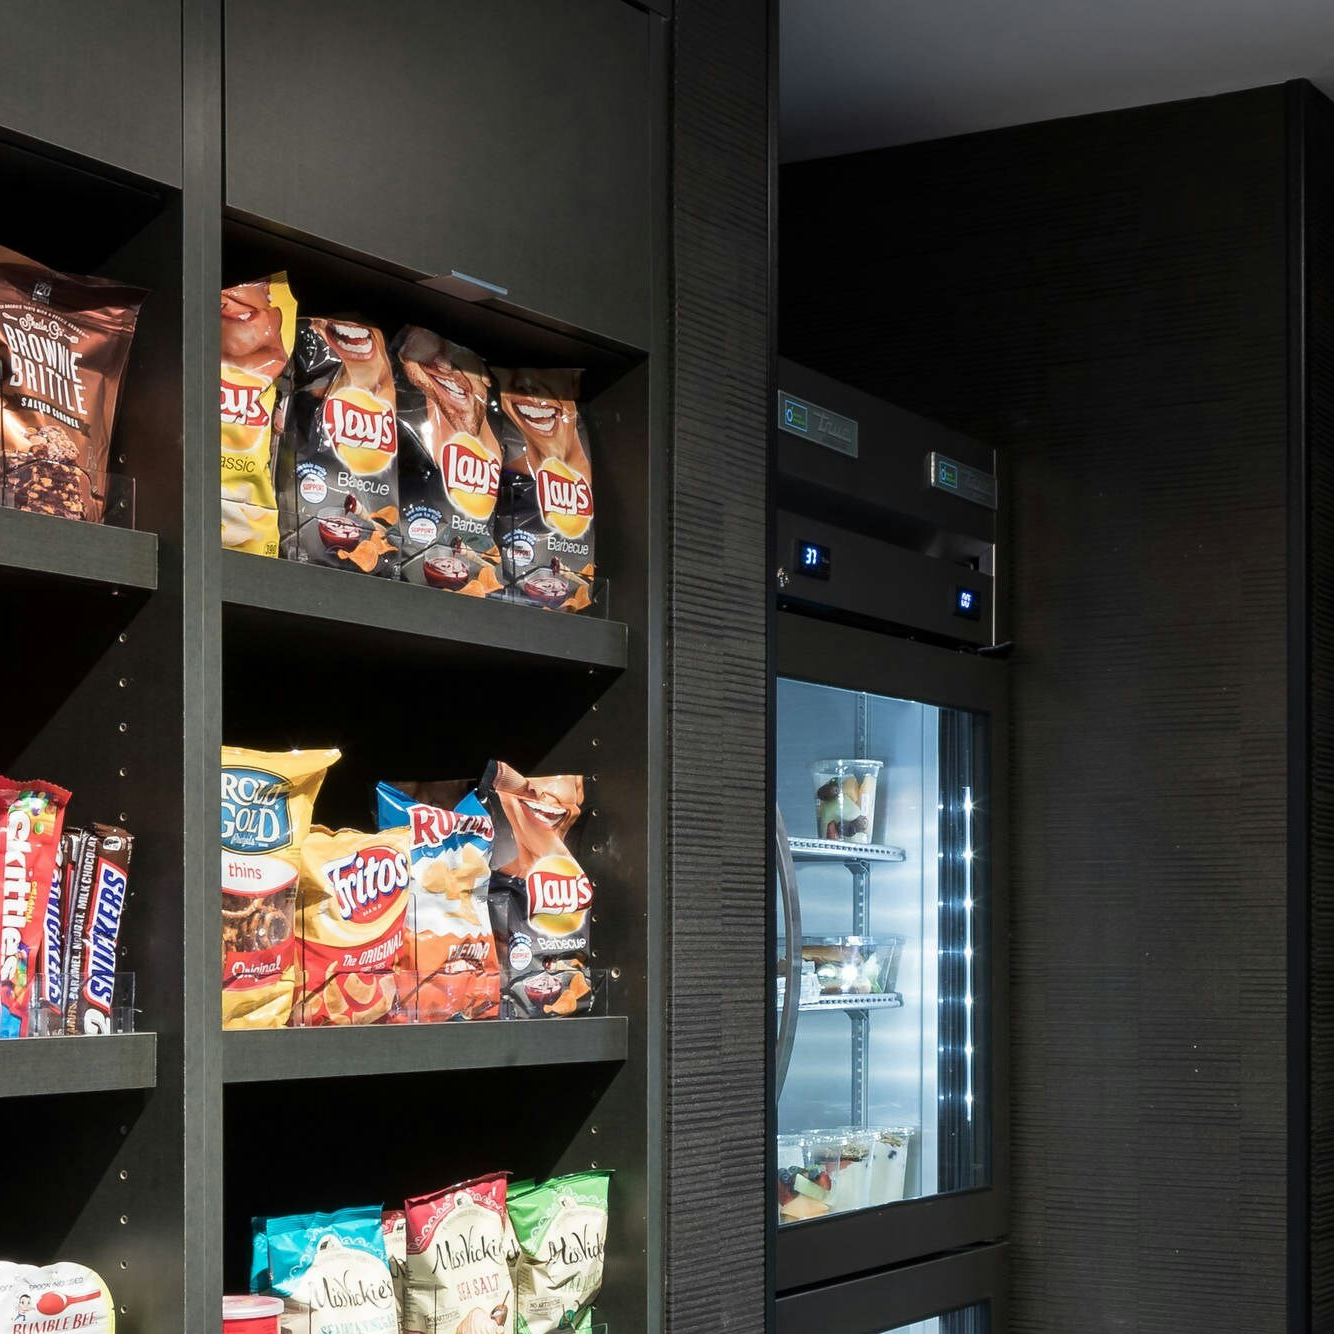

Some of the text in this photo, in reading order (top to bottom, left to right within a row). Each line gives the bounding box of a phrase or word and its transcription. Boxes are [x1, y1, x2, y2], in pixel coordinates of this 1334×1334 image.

[2, 323, 84, 384] BROWNIE
[10, 354, 88, 415] BRITTLE
[331, 398, 395, 449] Lay's
[448, 445, 500, 493] Lay's
[543, 470, 591, 516] Lay's
[547, 537, 589, 555] Barbecue
[805, 548, 817, 565] 37
[228, 862, 262, 880] thins
[327, 853, 409, 920] Fritos
[1, 811, 32, 981] Skittles
[79, 881, 89, 911] MILK
[535, 873, 593, 914] Lay's
[90, 868, 127, 1007] SNICKERS
[343, 952, 357, 967] The
[358, 935, 404, 966] ORIGINAL
[537, 936, 587, 951] Barbecue
[231, 957, 281, 983] Original
[472, 1273, 500, 1297] SALT
